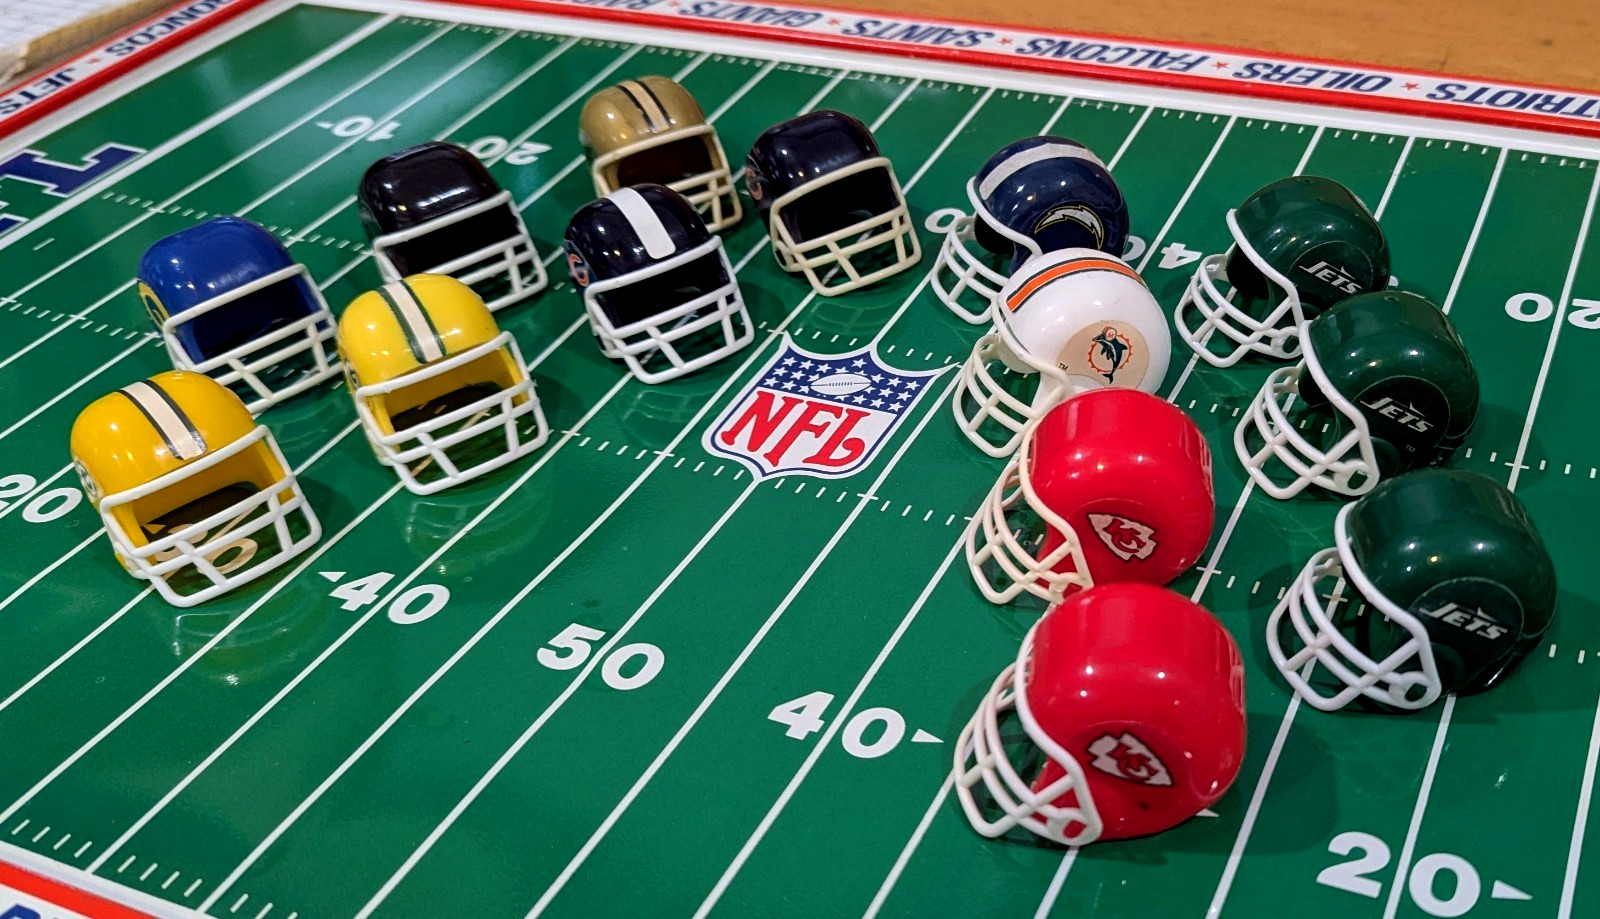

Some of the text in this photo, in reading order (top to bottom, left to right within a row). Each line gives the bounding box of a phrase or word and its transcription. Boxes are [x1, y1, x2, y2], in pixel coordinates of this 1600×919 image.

[678, 2, 823, 27] GIANTS
[843, 20, 996, 47] SAINTS
[1015, 38, 1210, 72] FALCONS
[0, 67, 75, 115] JETS
[1232, 62, 1393, 92] OILERS
[1425, 83, 1600, 119] TRIOTS
[331, 116, 400, 141] 10
[467, 136, 553, 165] 20
[1298, 261, 1363, 295] JETS
[720, 390, 871, 467] NFL
[1360, 397, 1434, 433] JETS
[329, 571, 450, 625] 40
[1419, 602, 1508, 640] JETS
[536, 623, 665, 690] 50
[767, 690, 906, 758] 40
[1316, 831, 1481, 918] 20
